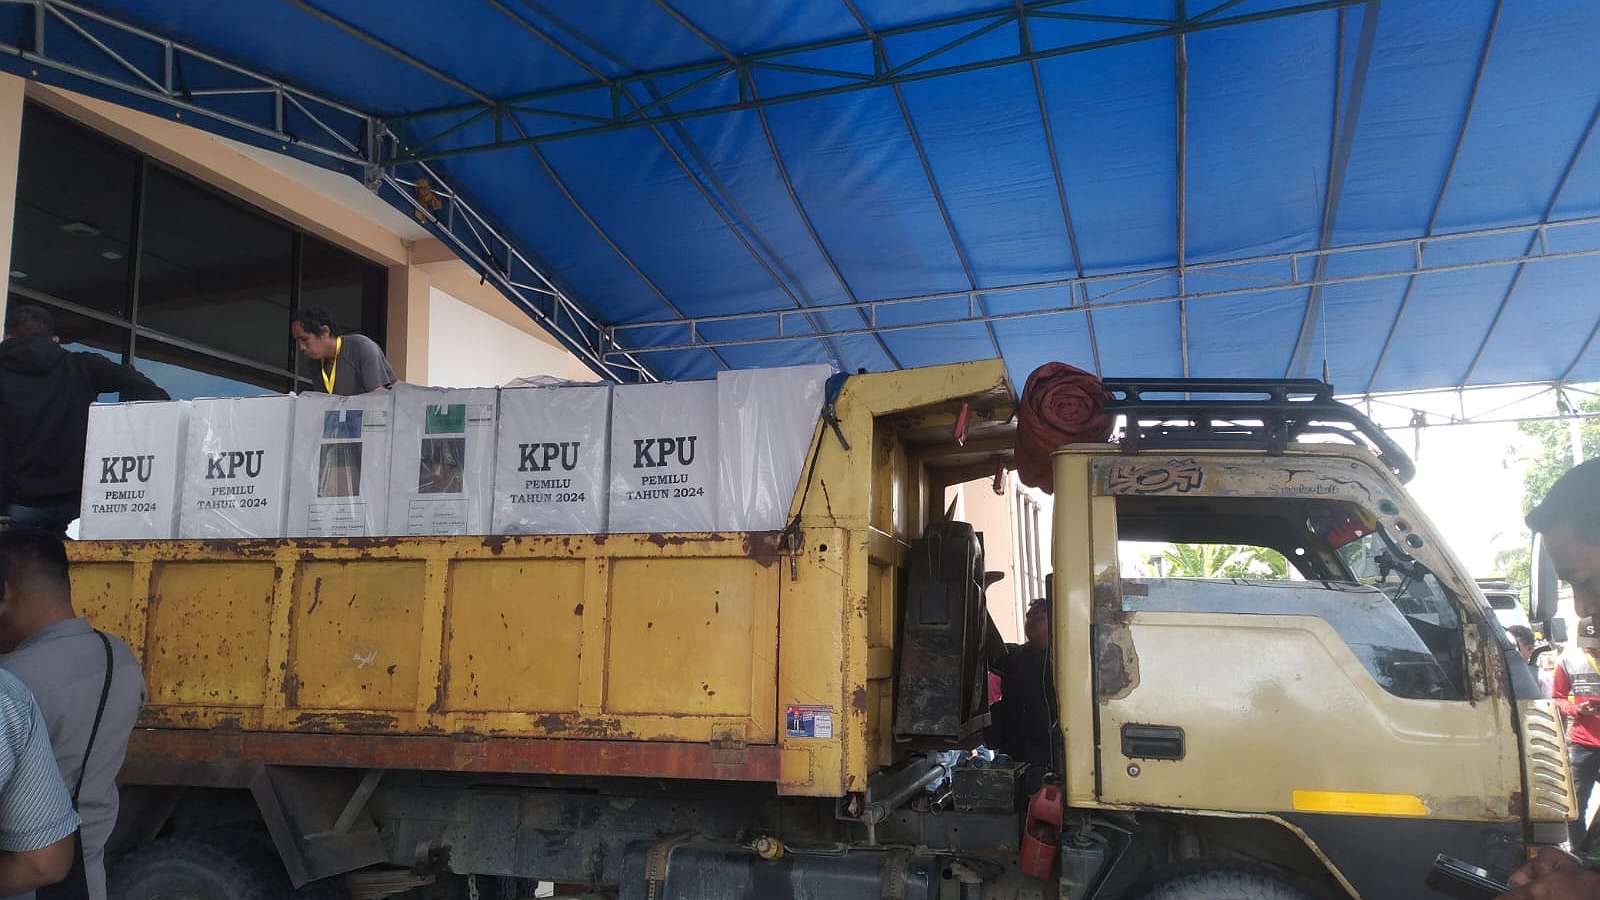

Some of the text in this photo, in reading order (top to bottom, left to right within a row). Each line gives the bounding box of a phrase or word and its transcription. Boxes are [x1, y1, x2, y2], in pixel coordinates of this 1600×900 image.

[518, 441, 581, 472] KPU
[632, 435, 697, 469] KPU
[100, 455, 155, 484] KPU
[205, 450, 265, 479] KPU
[526, 479, 571, 489] PEMILU
[641, 474, 689, 486] PEMILU
[105, 490, 145, 500] PEMILU
[211, 485, 256, 496] PEMILU
[626, 487, 705, 500] TAHUN 2024
[239, 498, 268, 508] 2024
[510, 492, 586, 504] TAHUN 2024
[92, 503, 157, 513] TAHUN 2024
